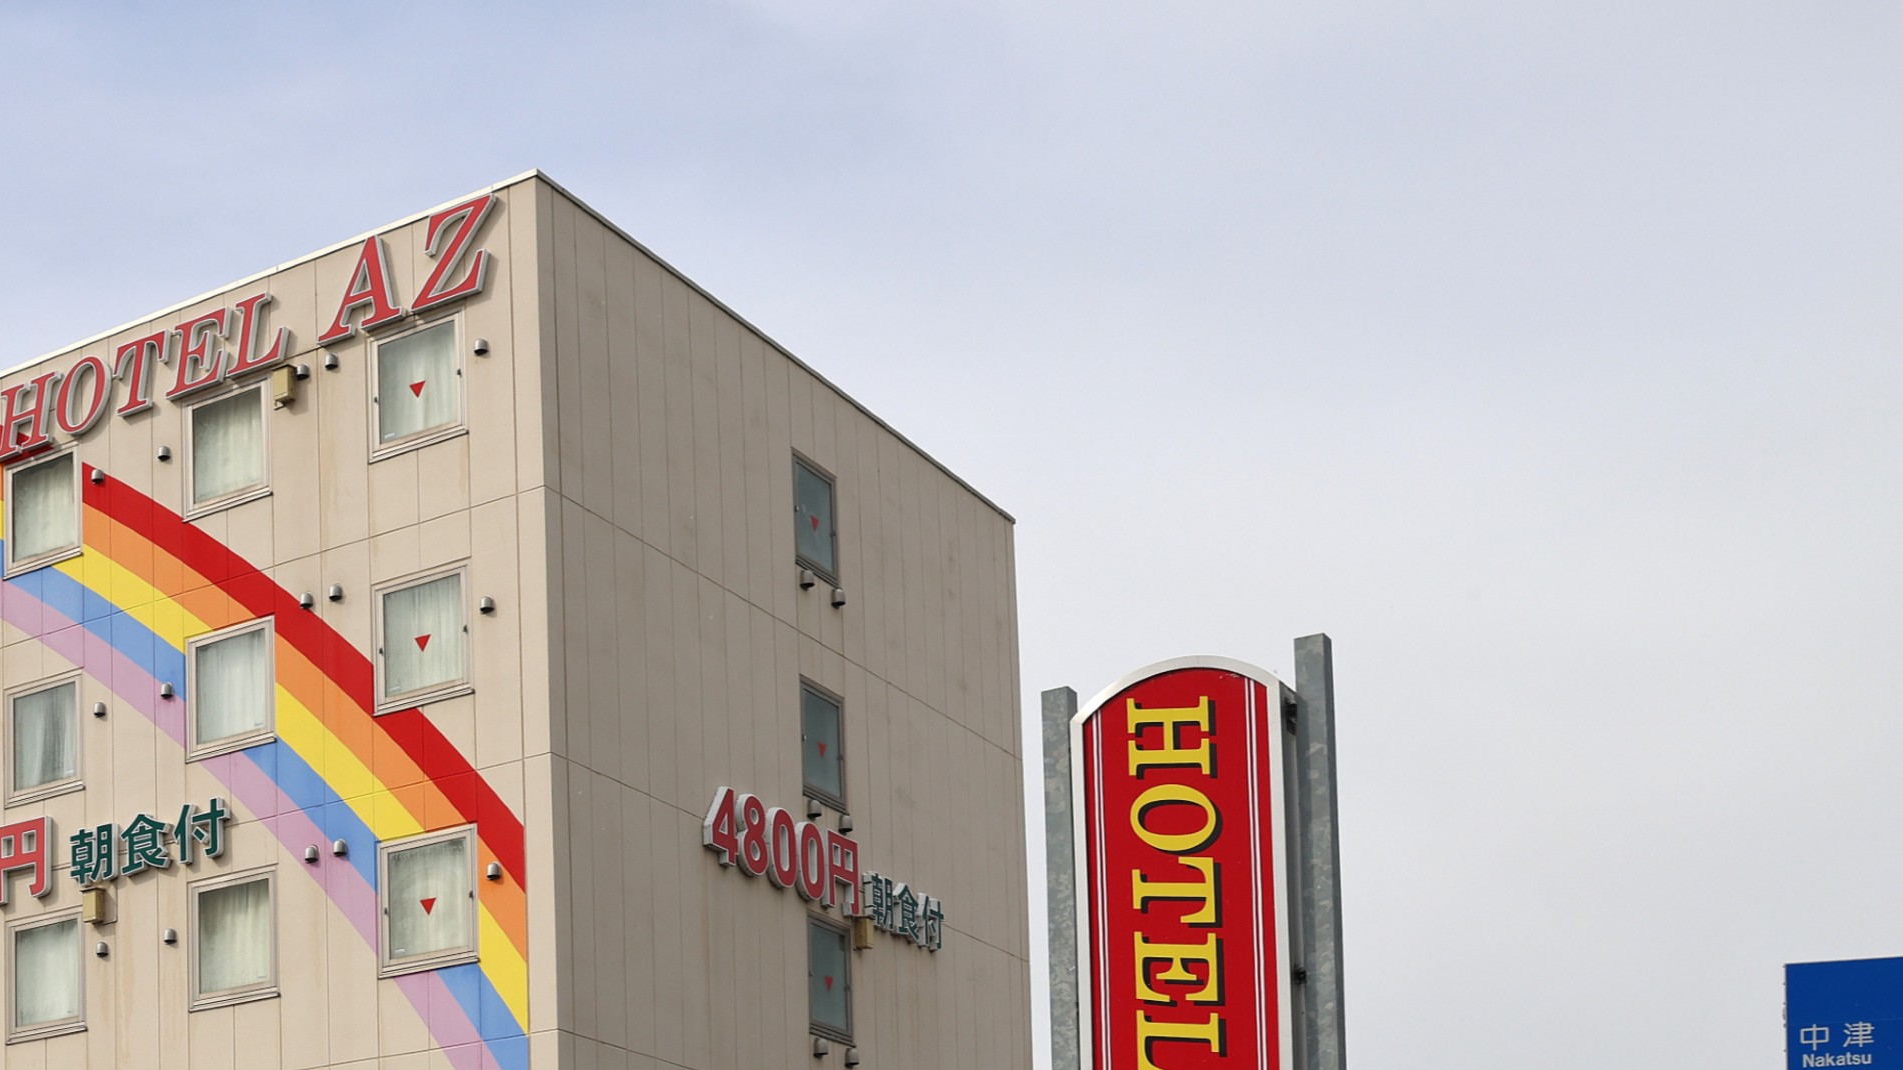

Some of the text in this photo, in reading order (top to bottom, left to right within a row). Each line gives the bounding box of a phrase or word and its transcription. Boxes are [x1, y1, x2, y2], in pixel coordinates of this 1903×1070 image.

[316, 192, 496, 346] AZ
[68, 796, 231, 887] 朝食付
[703, 785, 945, 951] 4800円 朝食付
[1800, 1021, 1875, 1051] 中津
[1802, 1052, 1873, 1069] Nakatsu
